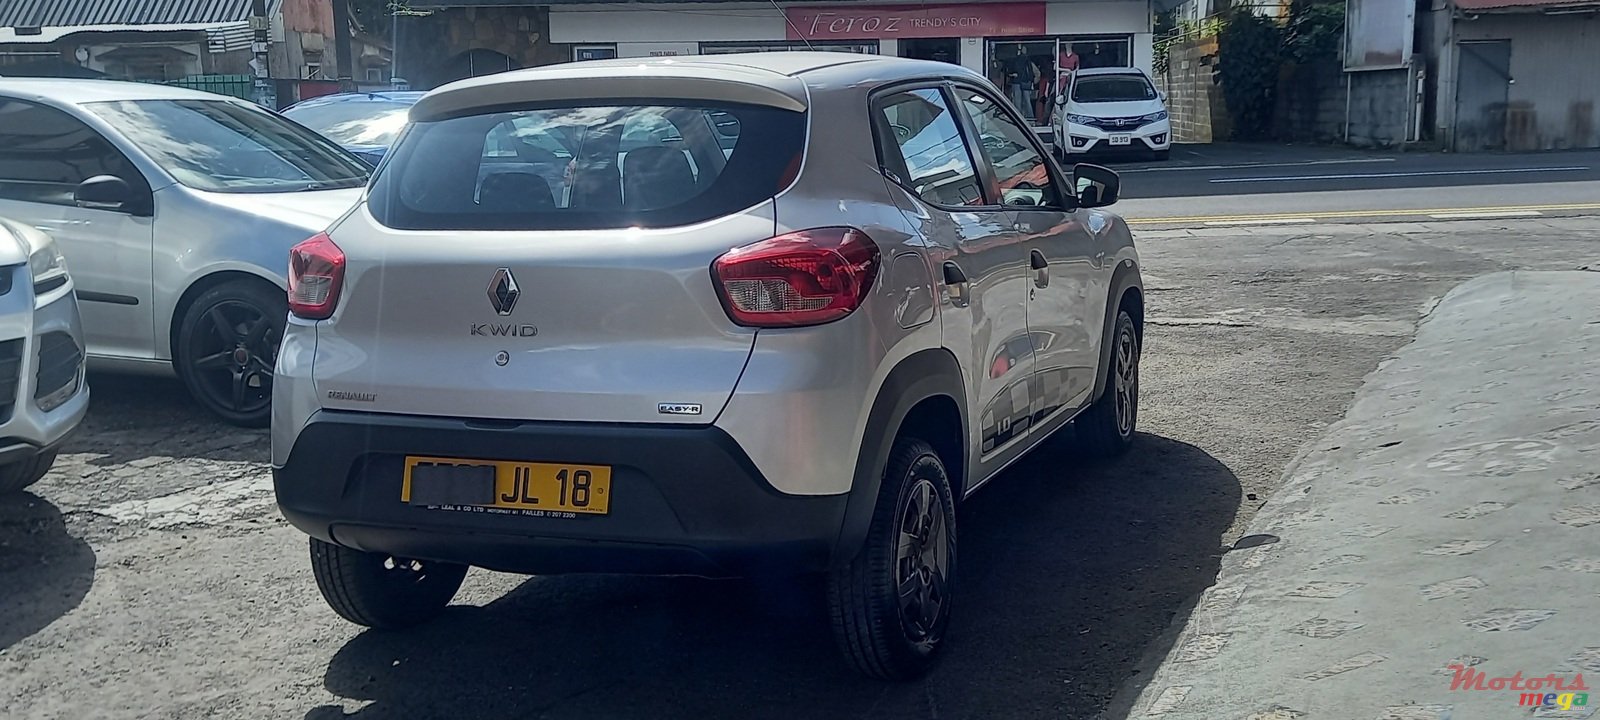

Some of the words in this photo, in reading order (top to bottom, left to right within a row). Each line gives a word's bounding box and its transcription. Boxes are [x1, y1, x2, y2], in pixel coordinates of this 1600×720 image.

[909, 17, 957, 28] TRENDY'S
[959, 17, 982, 27] CITY
[470, 322, 538, 337] KWID
[327, 390, 378, 402] RENAULT
[501, 466, 540, 503] JL
[556, 468, 592, 507] 18
